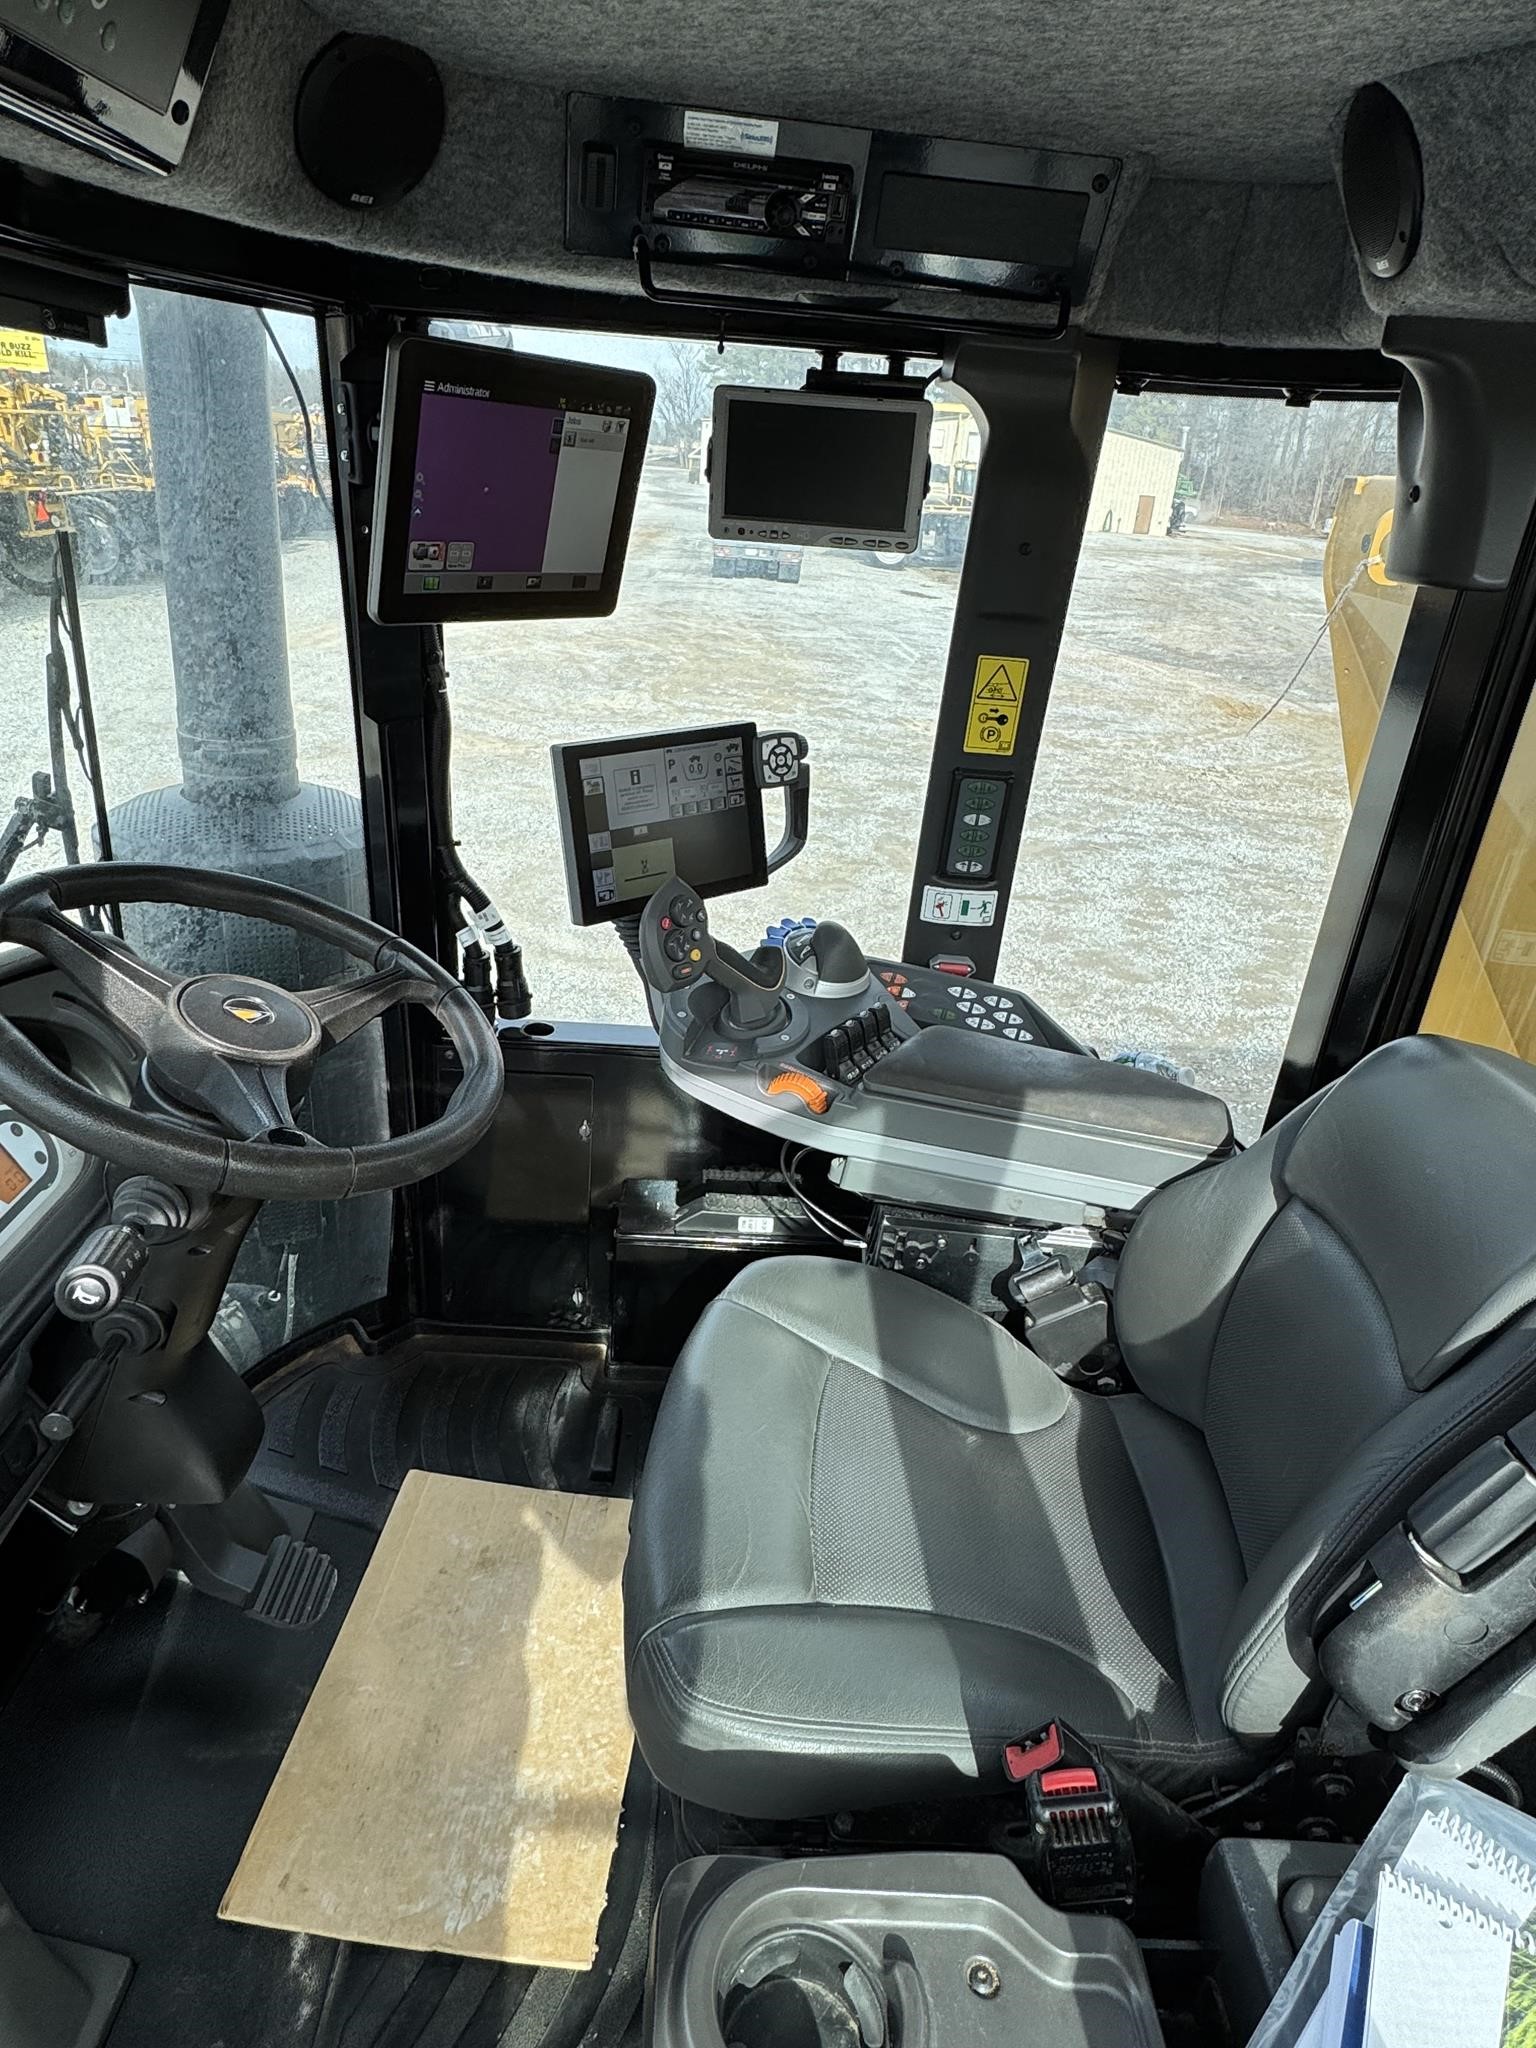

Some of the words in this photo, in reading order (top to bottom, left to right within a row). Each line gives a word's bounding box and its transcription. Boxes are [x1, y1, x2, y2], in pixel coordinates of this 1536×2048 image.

[733, 161, 768, 171] DELPHI
[350, 193, 374, 204] REI
[9, 342, 32, 351] BUZZ
[437, 381, 491, 398] Administrator
[668, 759, 676, 770] P
[688, 763, 703, 773] 0.0
